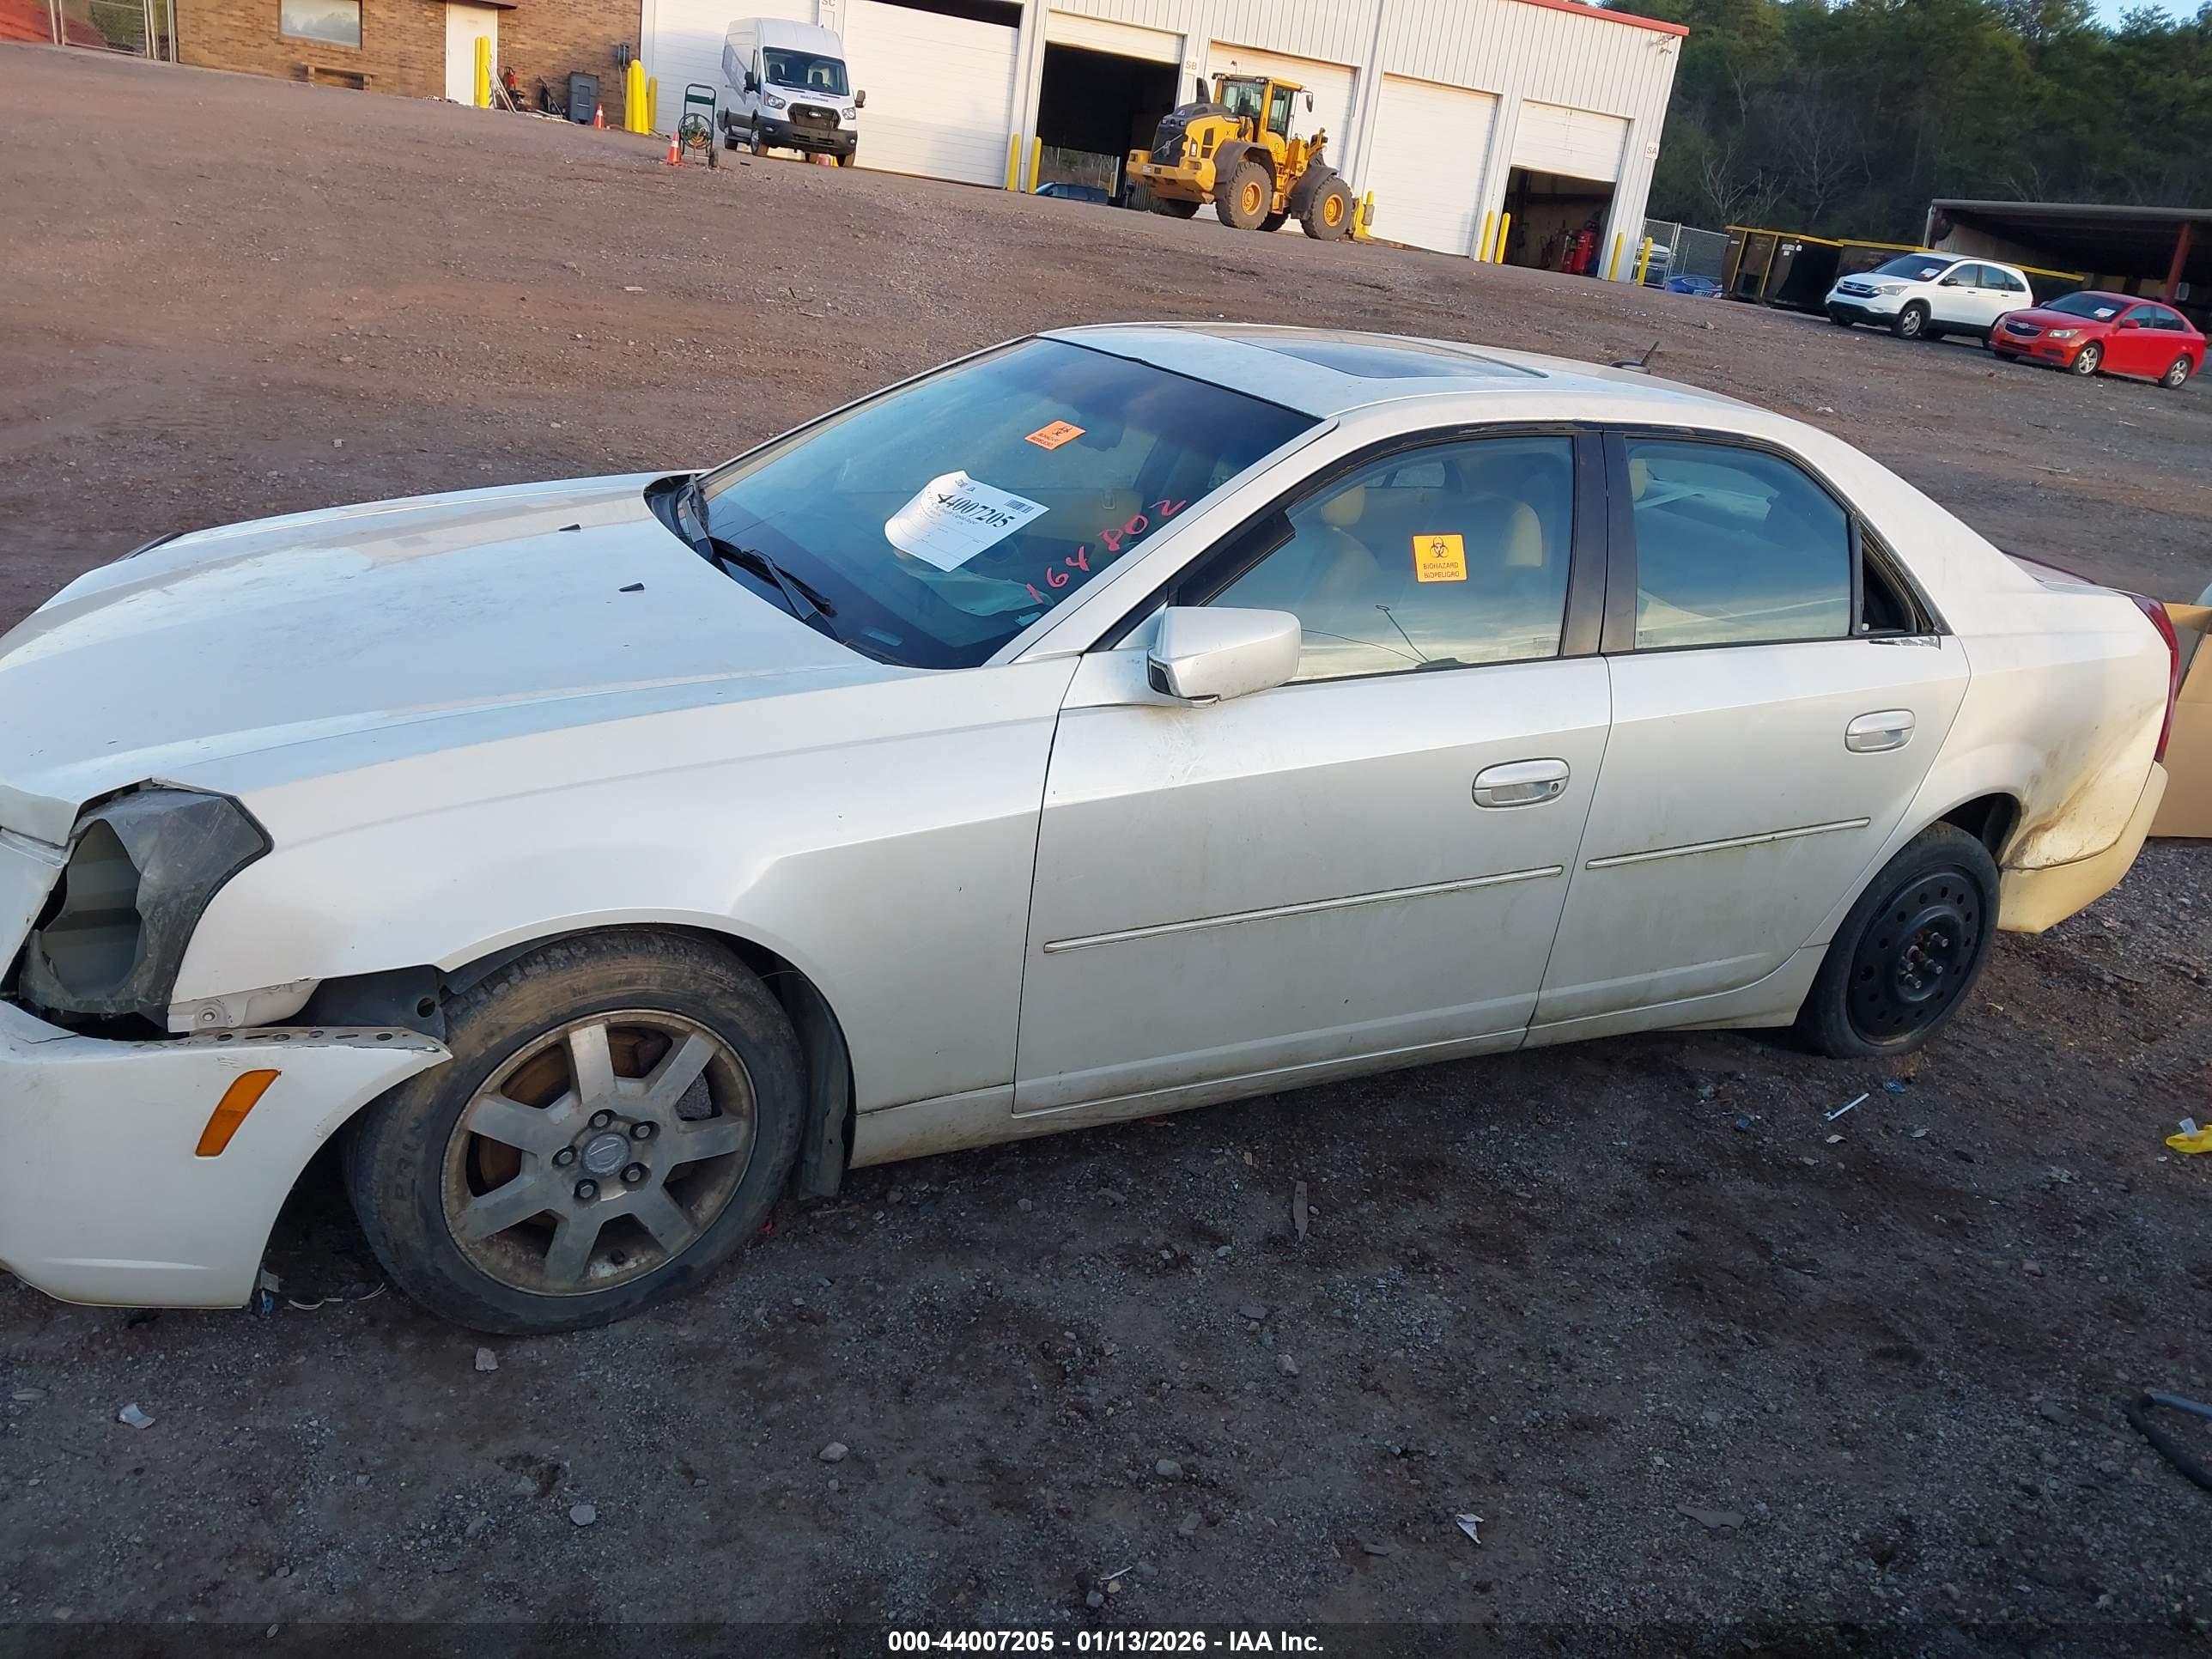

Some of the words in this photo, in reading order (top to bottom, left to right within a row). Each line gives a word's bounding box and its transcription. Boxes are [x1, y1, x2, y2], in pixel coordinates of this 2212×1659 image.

[1185, 60, 1198, 70] SB
[1646, 146, 1657, 155] SA
[937, 492, 1018, 528] 44007205
